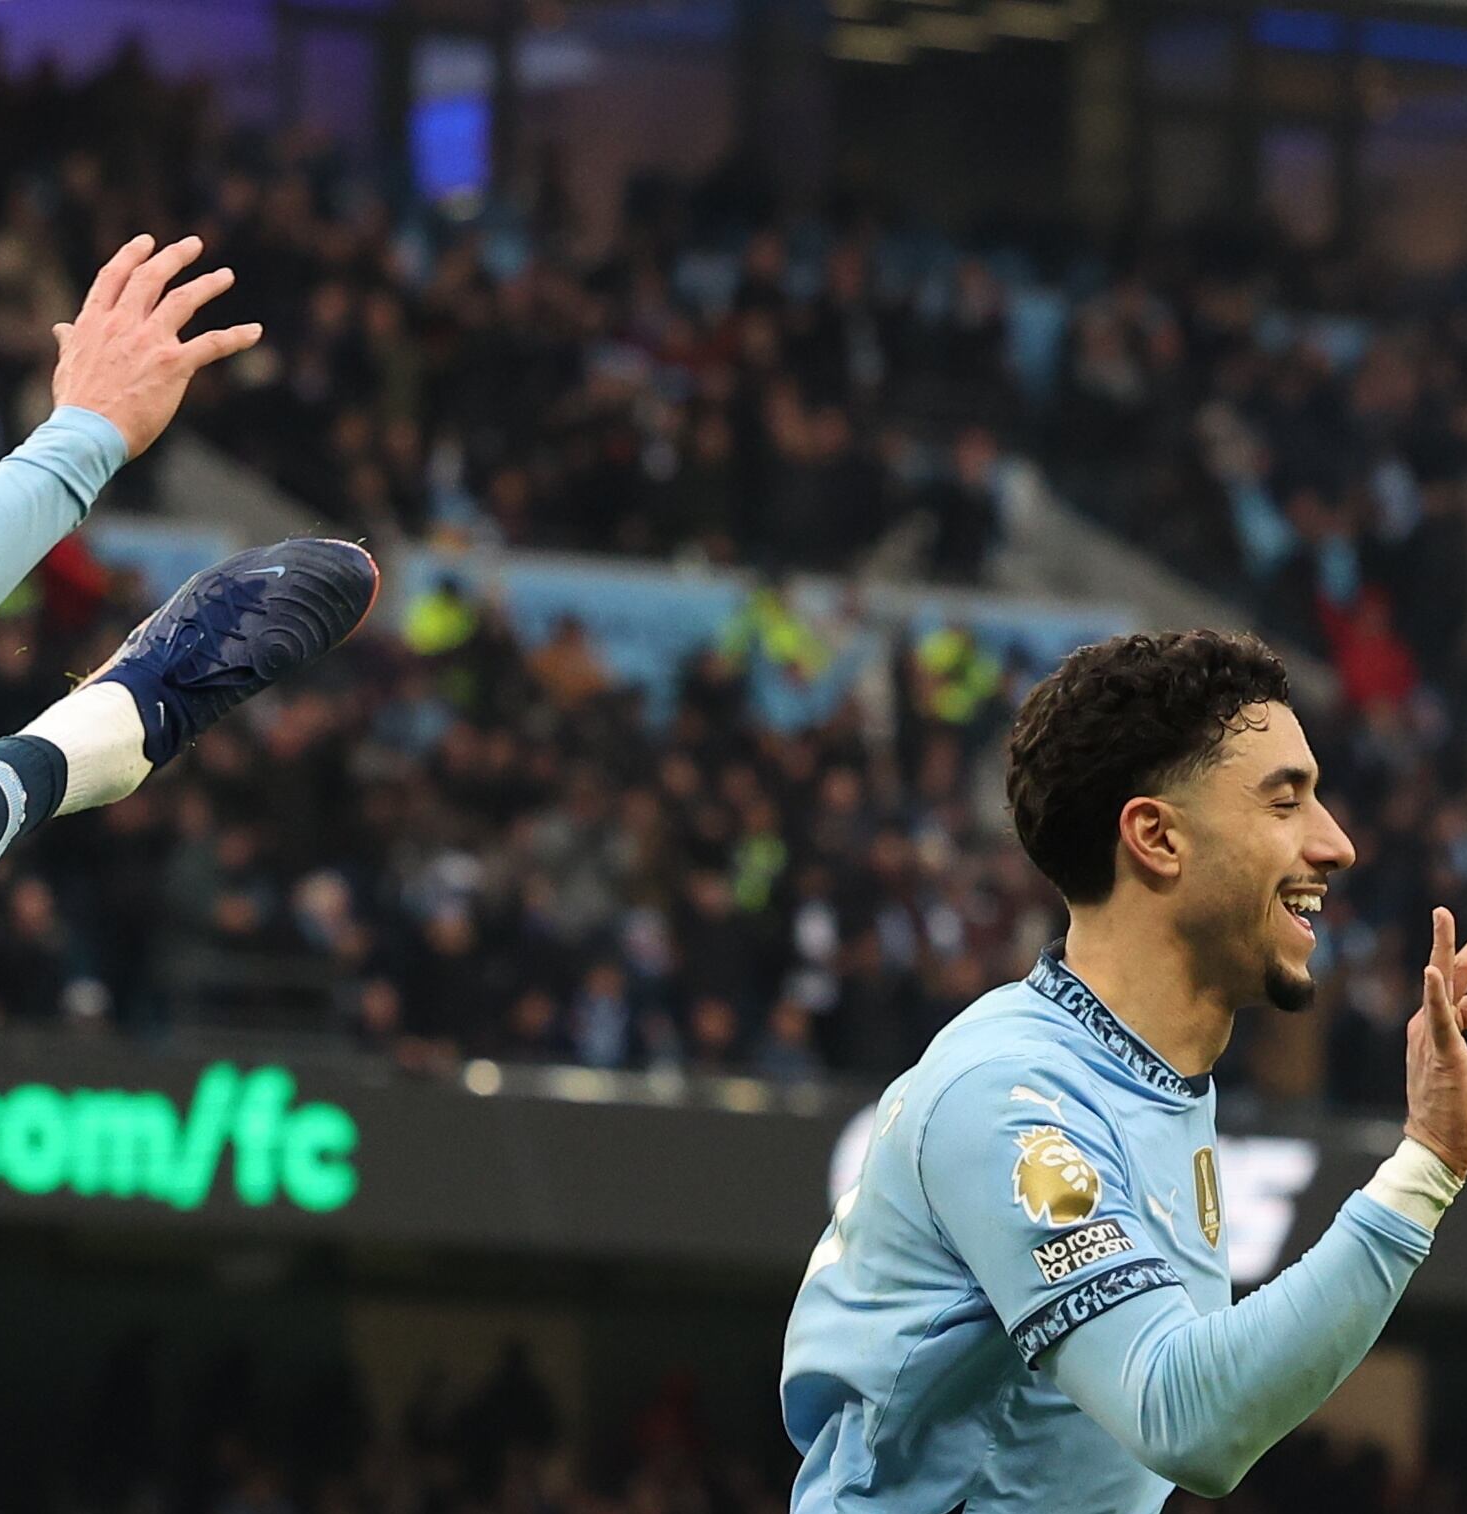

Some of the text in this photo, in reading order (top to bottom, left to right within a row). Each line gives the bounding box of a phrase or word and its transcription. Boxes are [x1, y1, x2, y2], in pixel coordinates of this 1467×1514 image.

[1033, 1223, 1120, 1268] No room
[1041, 1237, 1136, 1284] for racism
